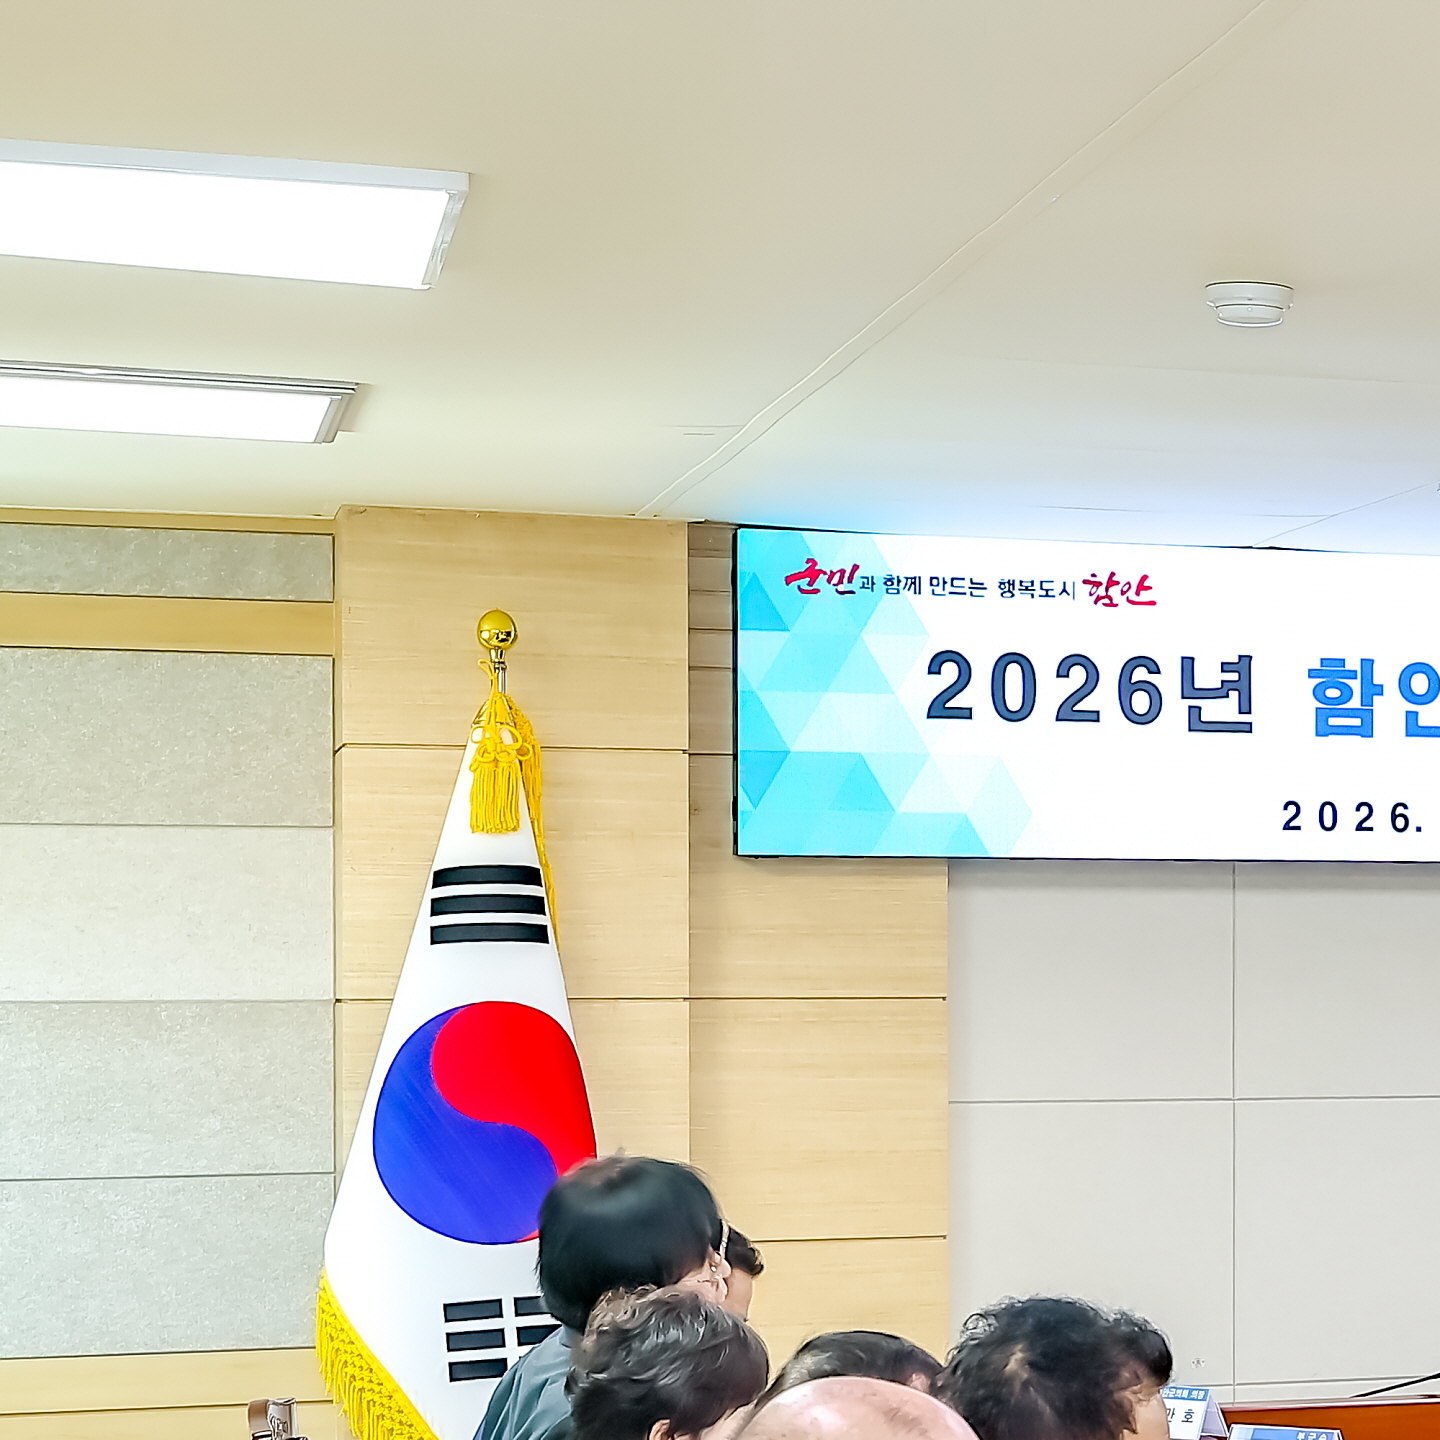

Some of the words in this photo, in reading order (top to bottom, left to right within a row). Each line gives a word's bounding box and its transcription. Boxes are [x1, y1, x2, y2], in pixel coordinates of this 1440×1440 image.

[882, 573, 922, 595] 함께
[929, 576, 988, 598] 만드는
[997, 578, 1076, 600] 행복도시
[1082, 571, 1158, 608] 함안
[924, 649, 1254, 735] 2026년
[1282, 800, 1423, 834] 2026.
